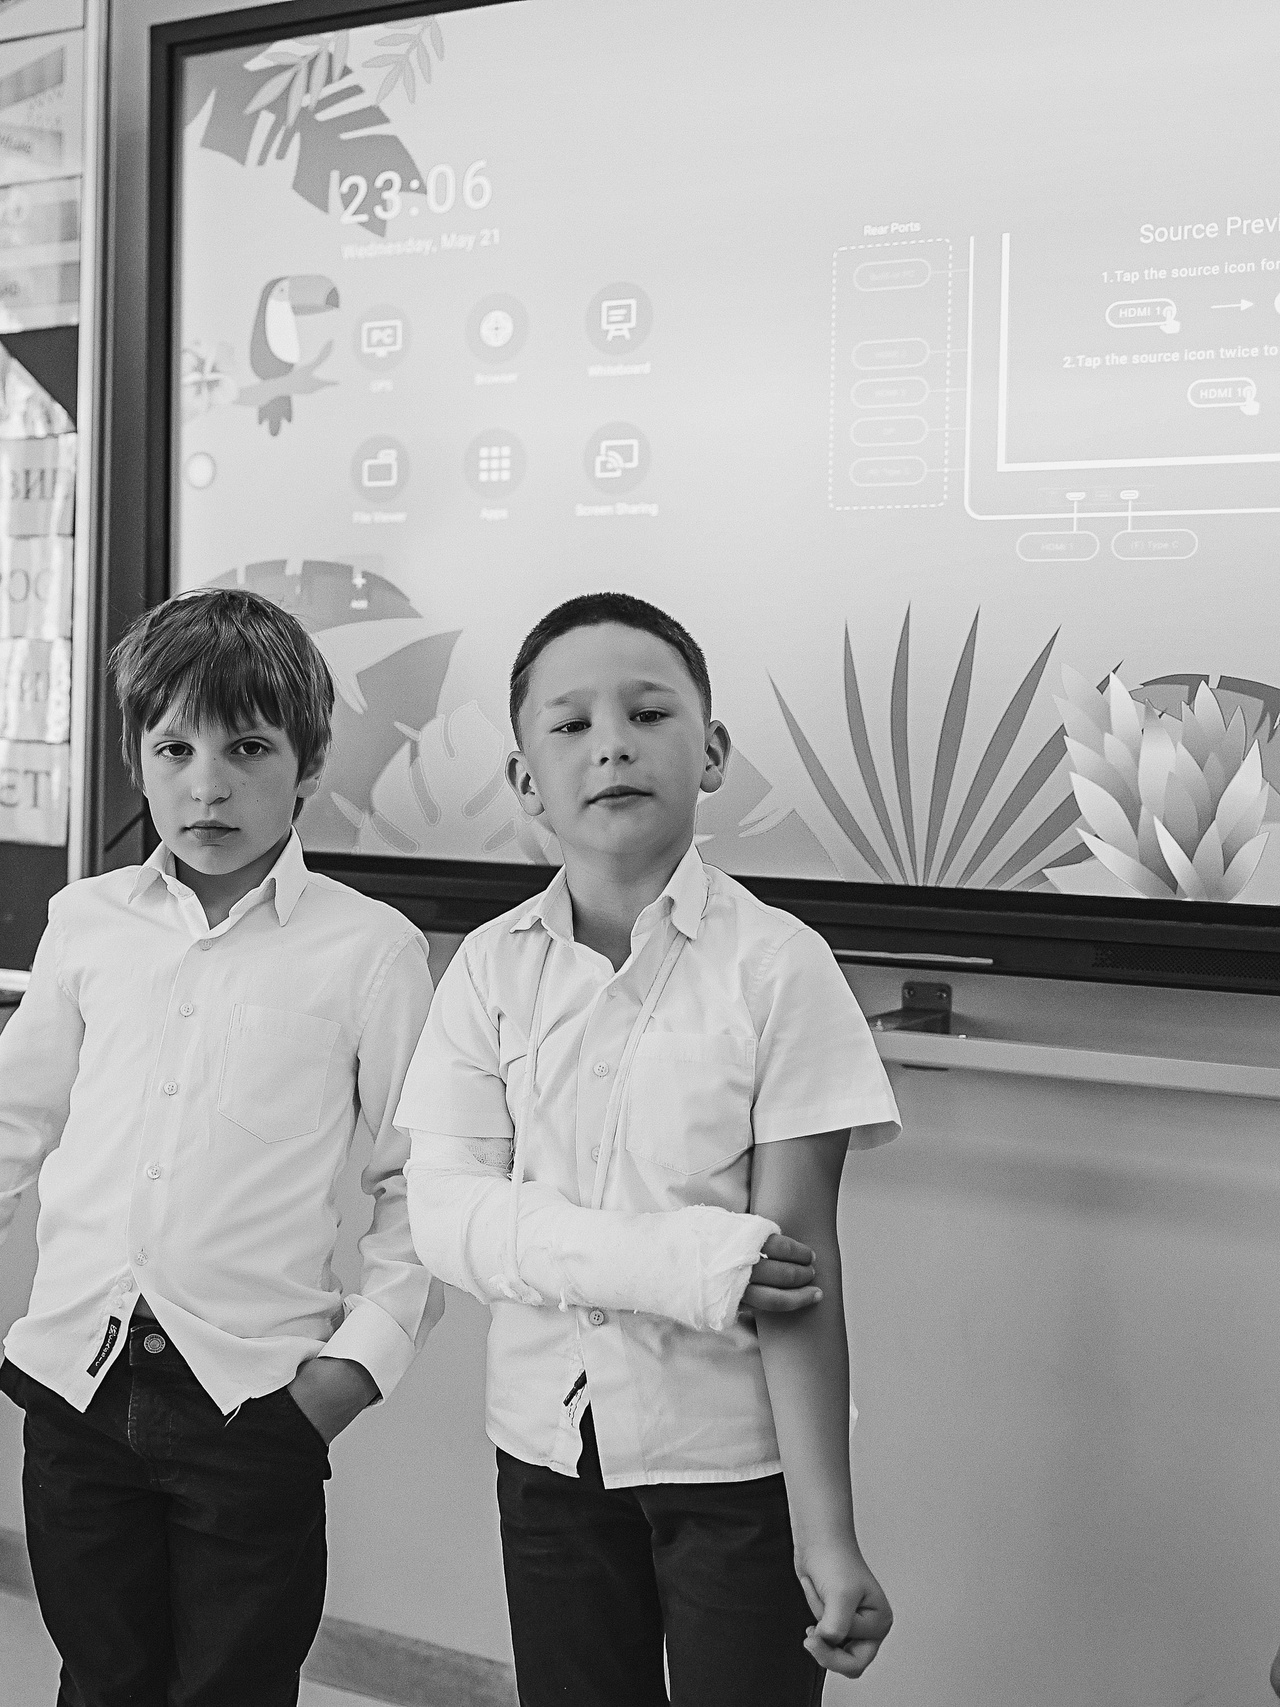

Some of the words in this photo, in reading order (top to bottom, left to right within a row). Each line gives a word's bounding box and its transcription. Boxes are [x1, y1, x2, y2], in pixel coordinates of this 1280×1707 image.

[339, 159, 492, 225] 23:06
[863, 224, 889, 236] Rear
[890, 221, 921, 234] Ports
[1140, 222, 1219, 244] Source
[441, 232, 476, 252] May
[480, 228, 500, 246] 21
[1144, 267, 1167, 281] the
[1171, 264, 1219, 279] source
[1224, 261, 1255, 274] icon
[1119, 307, 1150, 318] HDMI
[1105, 353, 1128, 366] the
[1132, 350, 1179, 364] source
[1184, 348, 1214, 361] icon
[1219, 345, 1258, 359] twice
[1263, 345, 1278, 356] to
[1200, 388, 1232, 399] HDMI
[575, 503, 613, 517] Screen
